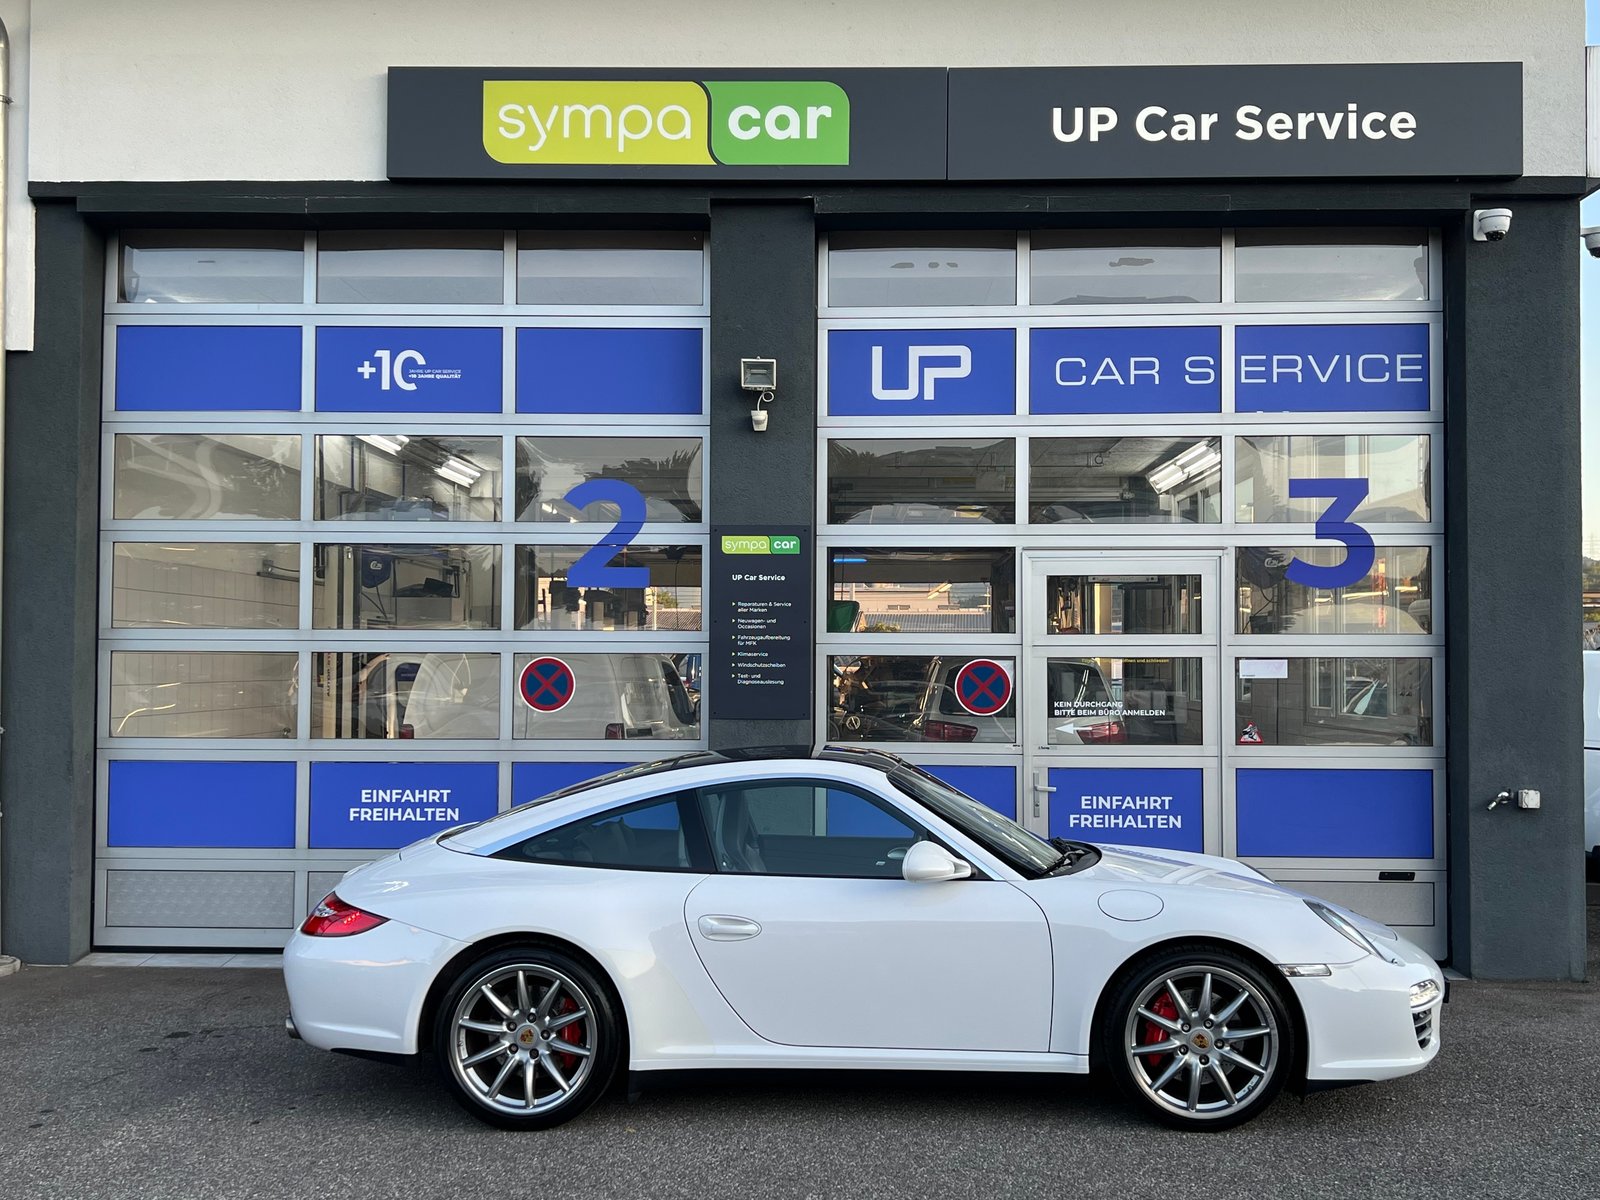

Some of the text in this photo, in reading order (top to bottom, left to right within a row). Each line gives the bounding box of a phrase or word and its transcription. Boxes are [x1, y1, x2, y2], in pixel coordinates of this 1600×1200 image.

[498, 103, 832, 152] sympa car
[1052, 103, 1417, 142] UP Car Service
[871, 345, 972, 401] UP
[1055, 357, 1160, 386] CAR
[563, 478, 651, 588] 2
[1283, 477, 1376, 590] 3
[724, 540, 797, 551] sympa car
[1098, 708, 1121, 716] BÜRO
[361, 789, 452, 803] EINFAHRT
[1081, 796, 1173, 810] EINFAHRT
[349, 807, 460, 821] FREIHALTEN
[1069, 814, 1182, 829] FREIHALTEN
